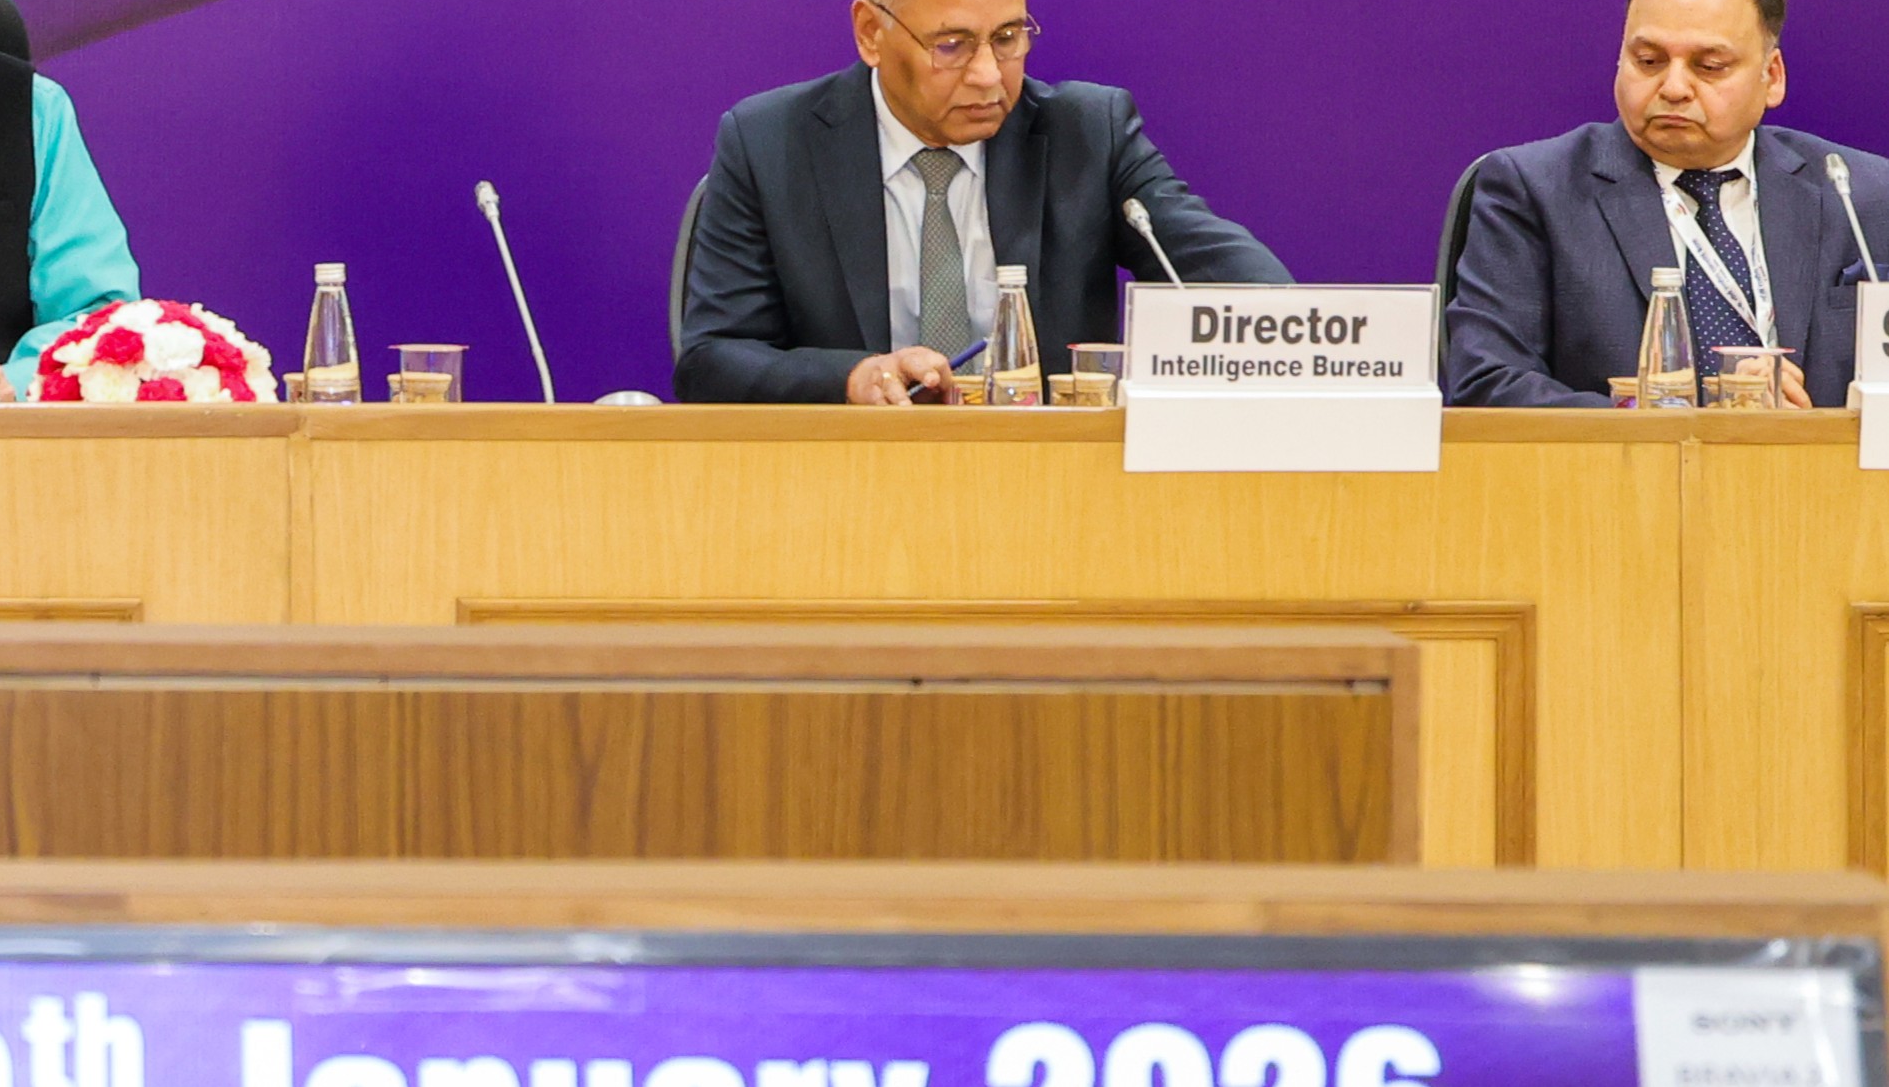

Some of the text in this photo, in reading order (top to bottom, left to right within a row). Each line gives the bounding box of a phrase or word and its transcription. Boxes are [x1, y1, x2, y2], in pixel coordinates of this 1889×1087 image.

[1191, 305, 1368, 346] Director
[1152, 354, 1403, 382] Intelligence Bureau
